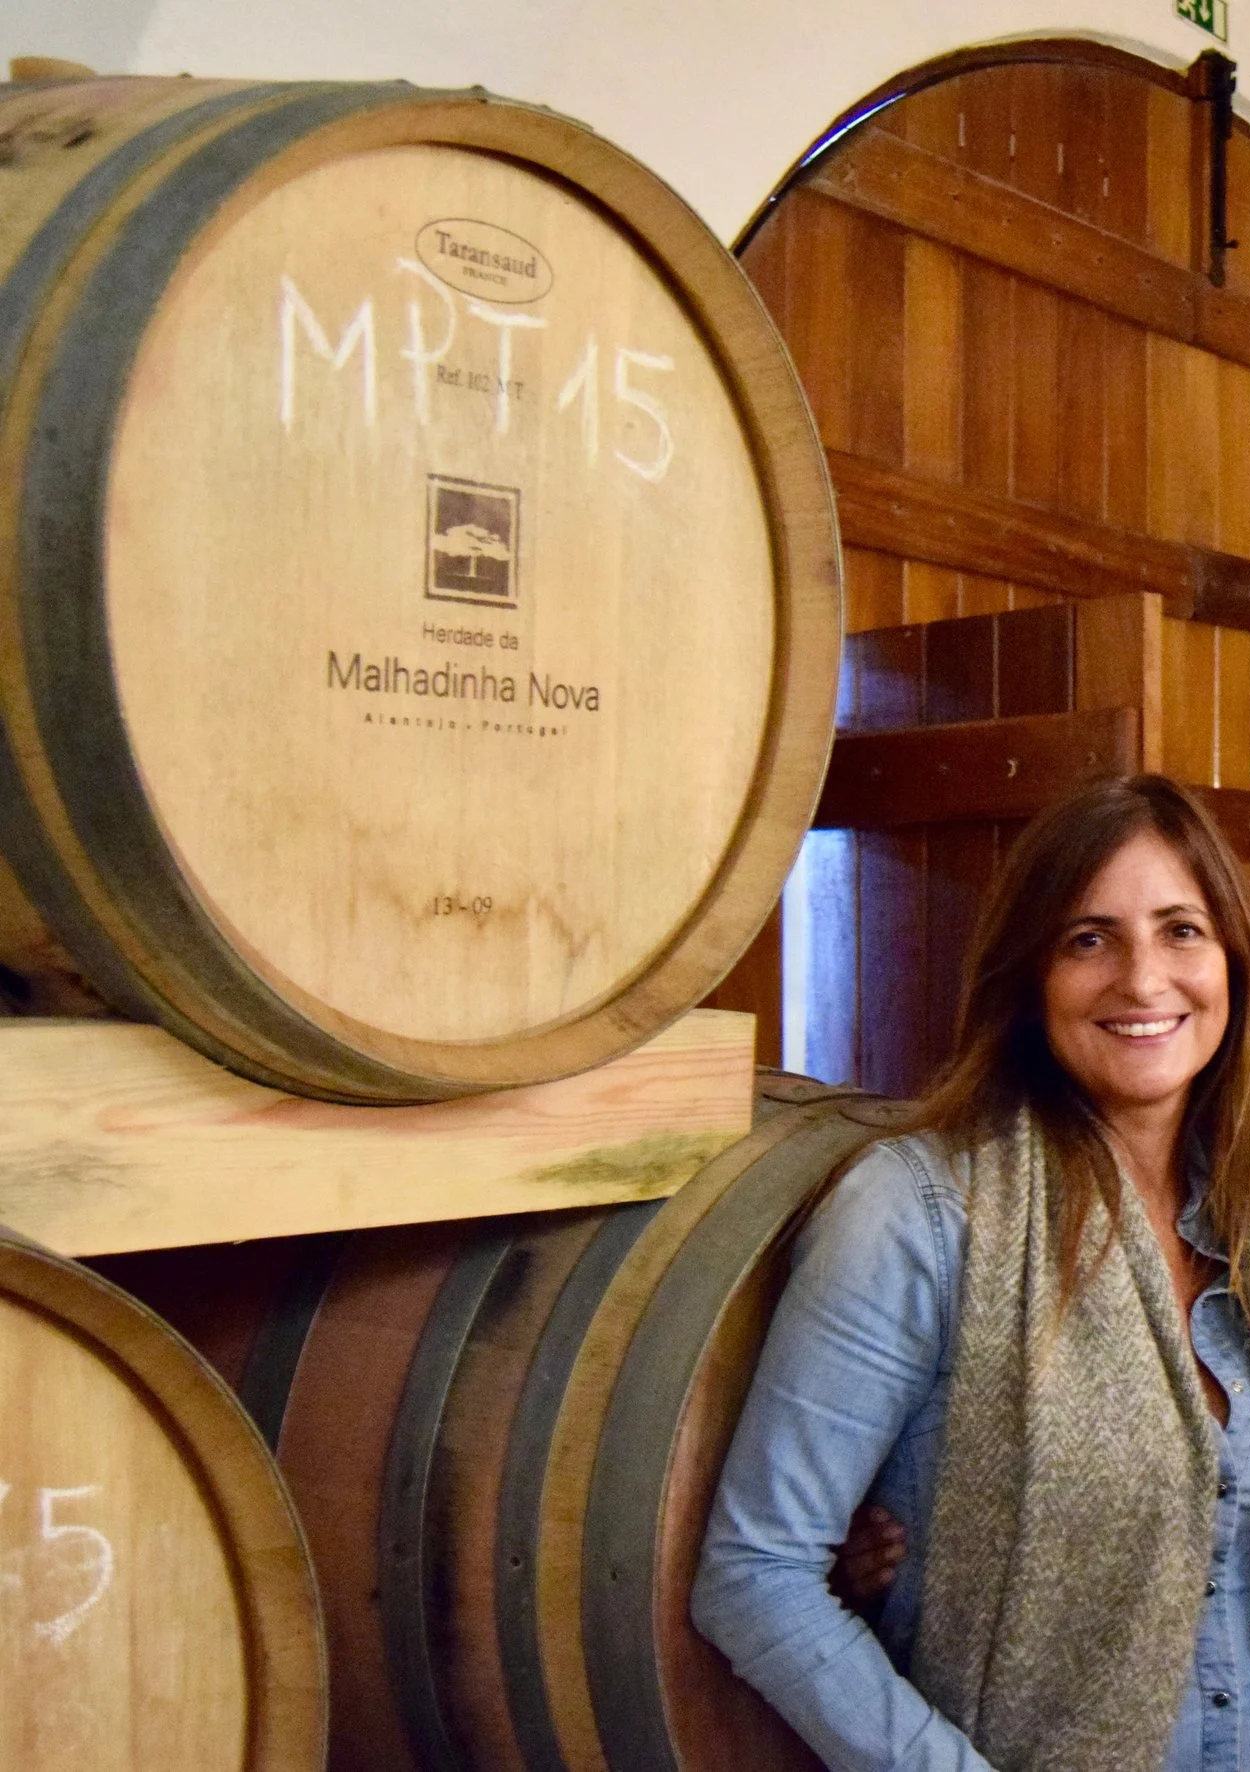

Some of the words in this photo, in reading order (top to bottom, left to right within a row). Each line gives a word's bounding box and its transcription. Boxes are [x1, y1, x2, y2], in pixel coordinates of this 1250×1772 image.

[435, 229, 537, 279] Taransaud
[555, 331, 676, 484] 15
[422, 621, 494, 648] Herdade
[498, 630, 519, 651] da
[326, 650, 516, 703] Malhadinha
[528, 671, 601, 712] Nova
